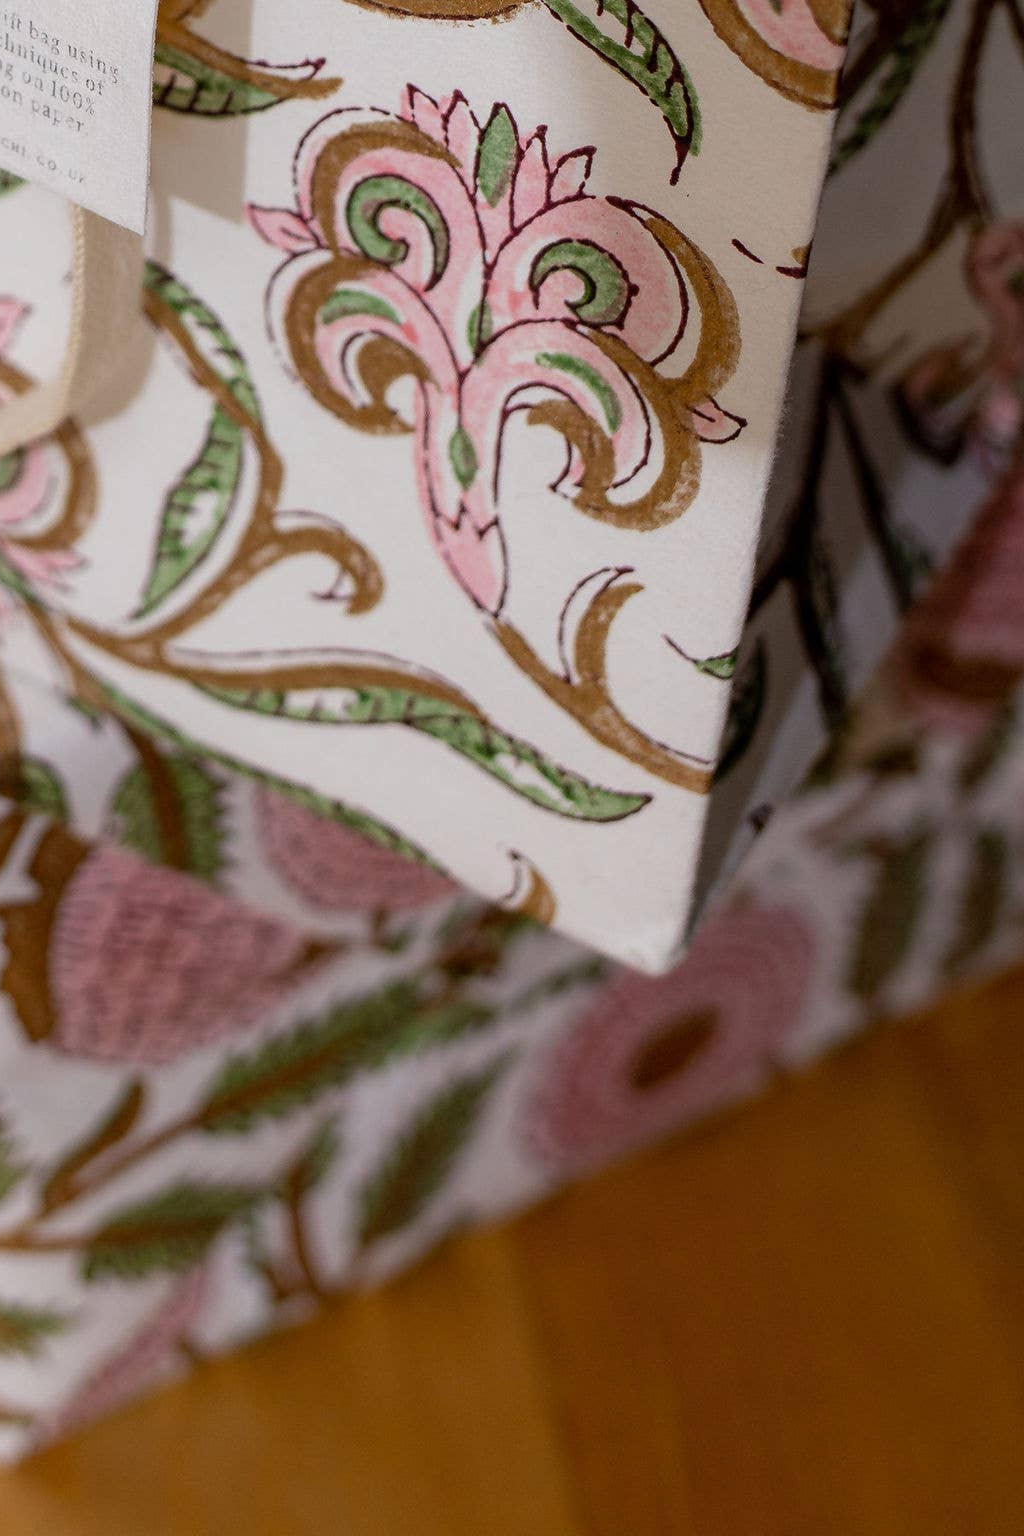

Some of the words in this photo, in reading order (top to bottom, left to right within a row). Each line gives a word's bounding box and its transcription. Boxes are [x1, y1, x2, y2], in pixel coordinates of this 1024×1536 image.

[29, 20, 60, 56] bag
[67, 44, 119, 85] using
[22, 71, 44, 92] on
[51, 80, 95, 116] 100%
[85, 77, 105, 97] of
